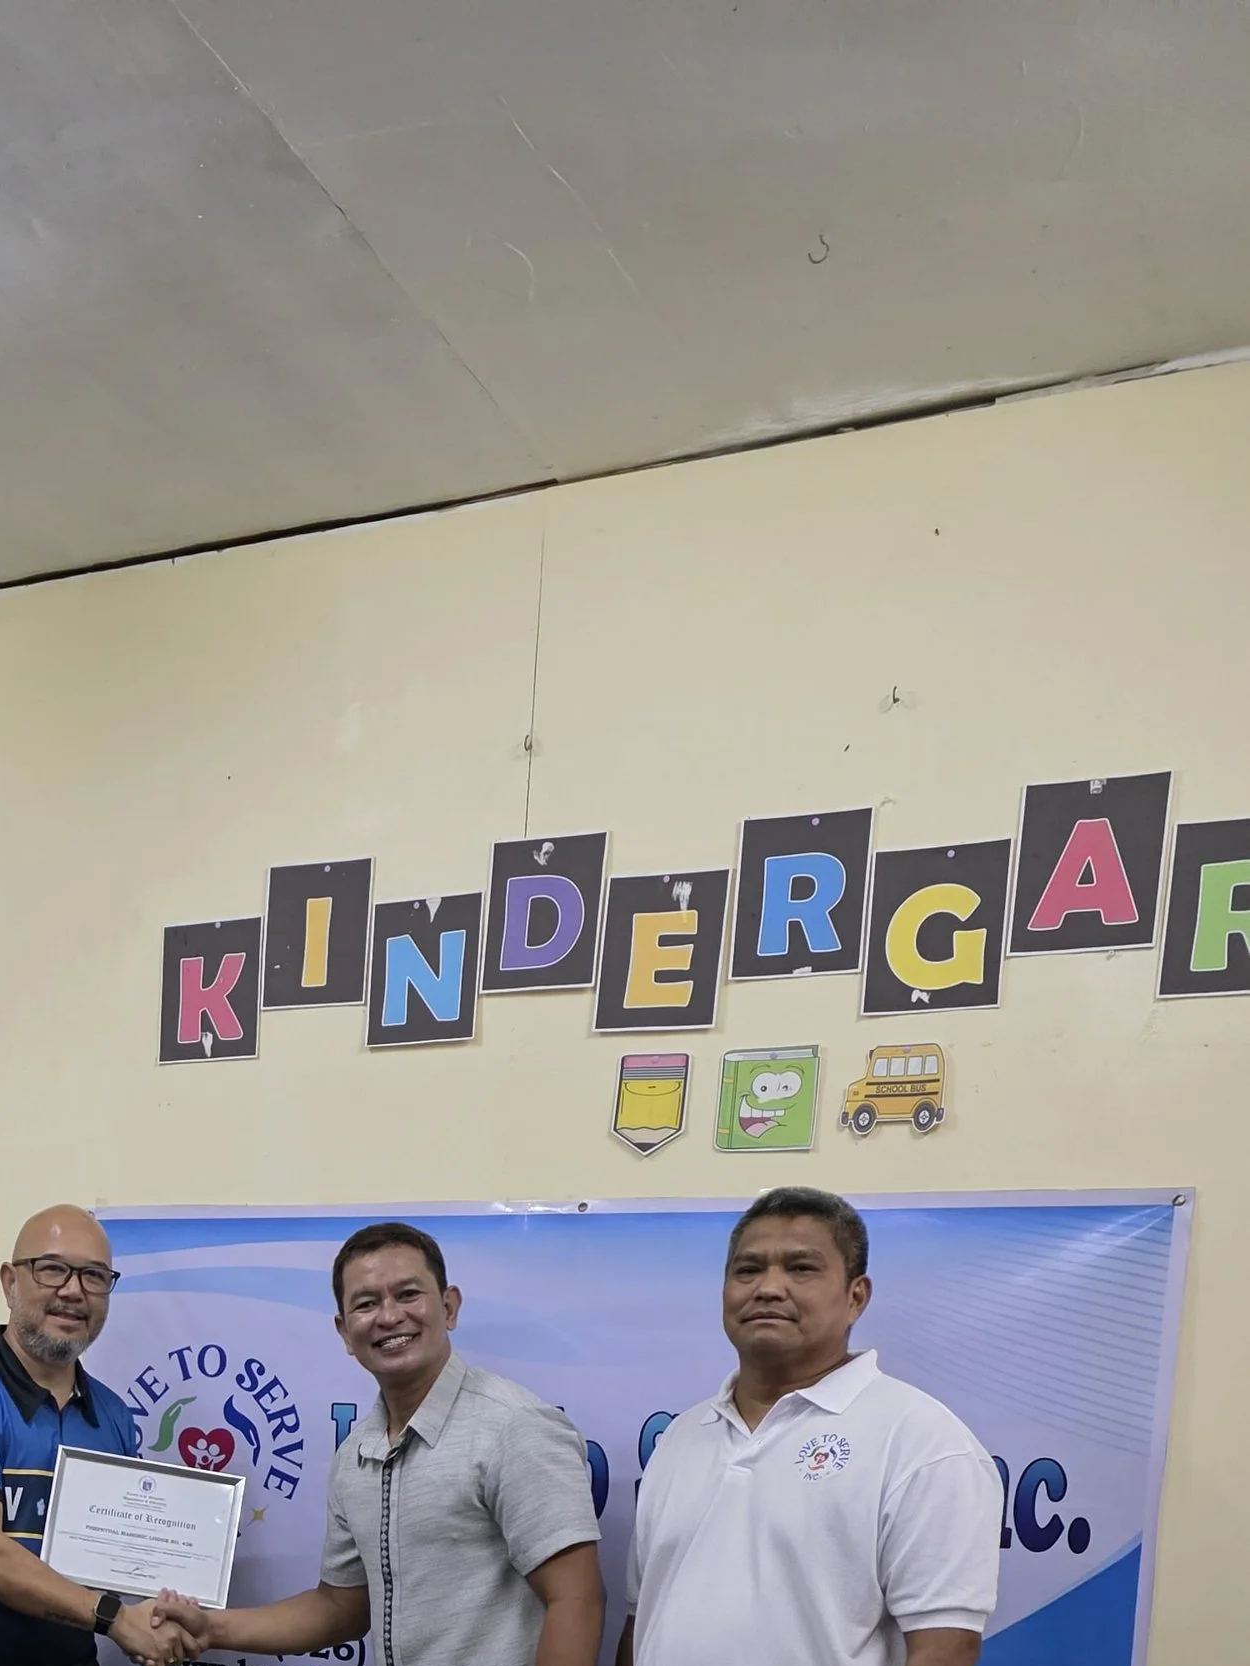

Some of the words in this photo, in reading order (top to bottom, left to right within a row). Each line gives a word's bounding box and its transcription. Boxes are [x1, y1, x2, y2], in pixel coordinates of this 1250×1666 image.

[875, 1085, 909, 1094] SCHOOL
[910, 1083, 927, 1092] BUS
[168, 1344, 227, 1382] TO
[235, 1358, 305, 1501] SERVE
[794, 1437, 820, 1464] LOVE
[821, 1433, 838, 1443] TO
[833, 1437, 851, 1471] SERVE
[89, 1504, 132, 1520] Certificate
[134, 1513, 143, 1521] of
[145, 1513, 197, 1531] Recognition
